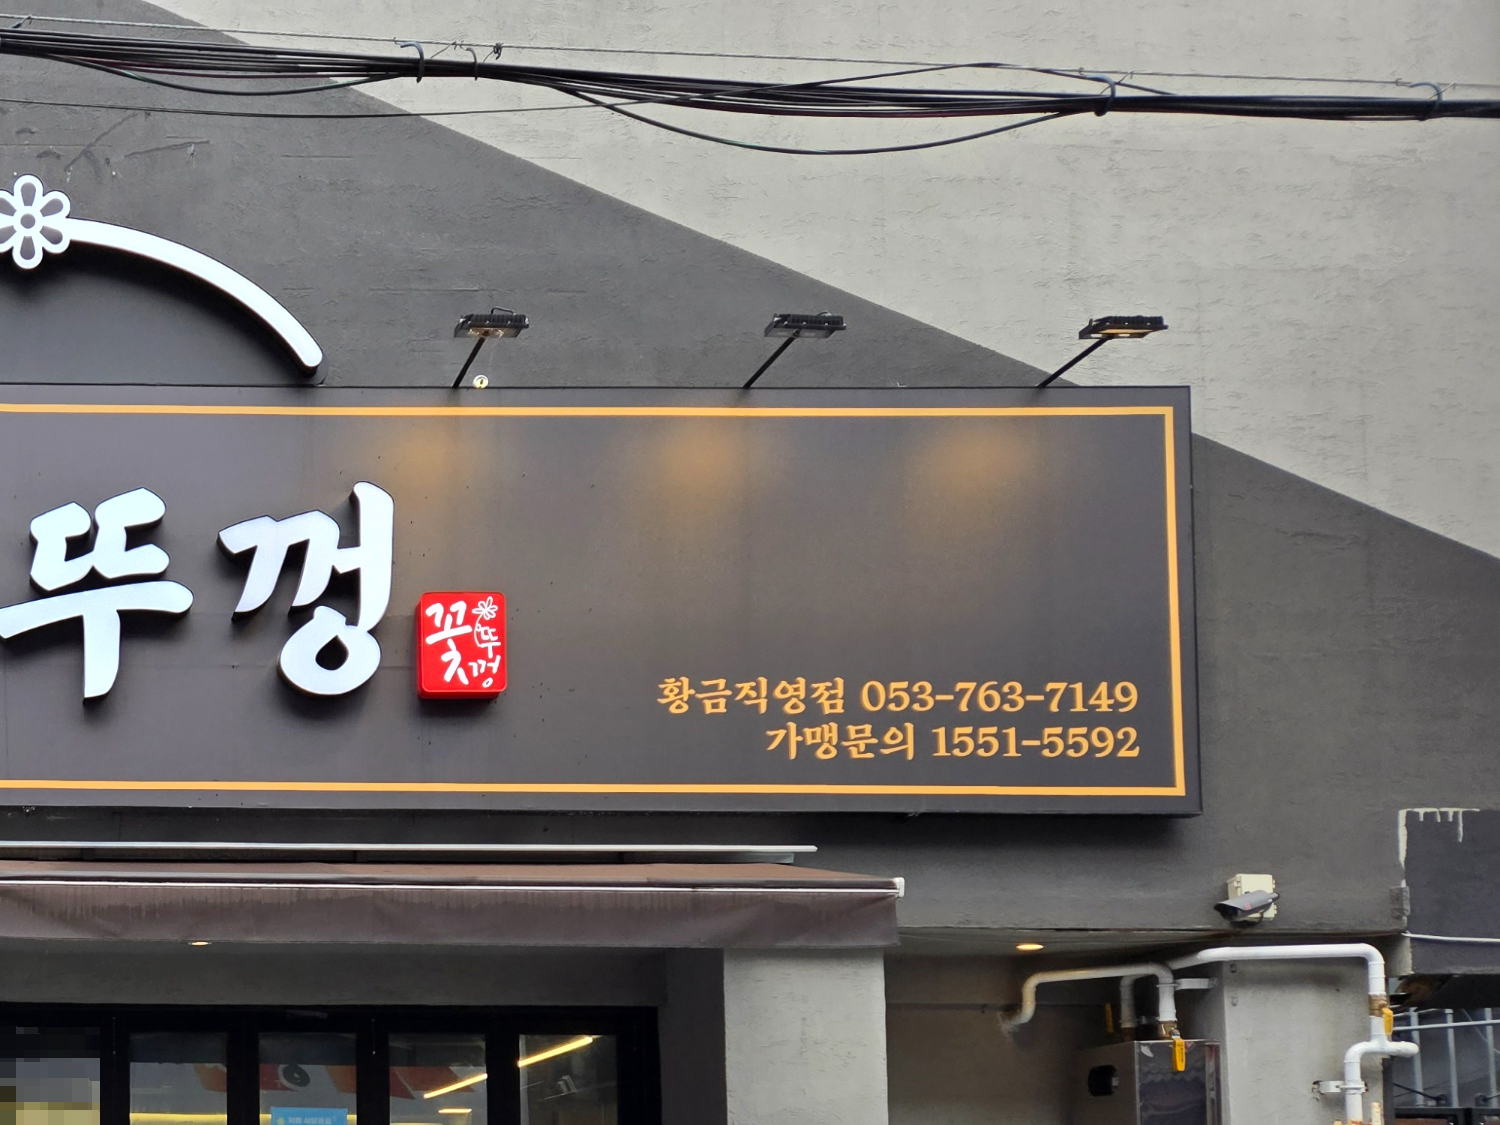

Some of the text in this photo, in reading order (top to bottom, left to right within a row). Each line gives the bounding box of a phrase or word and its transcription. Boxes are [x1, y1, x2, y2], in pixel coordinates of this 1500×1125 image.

[657, 676, 1139, 716] 황금직영점 053-763-7149
[766, 721, 1140, 760] 가맹문의 1551-5592
